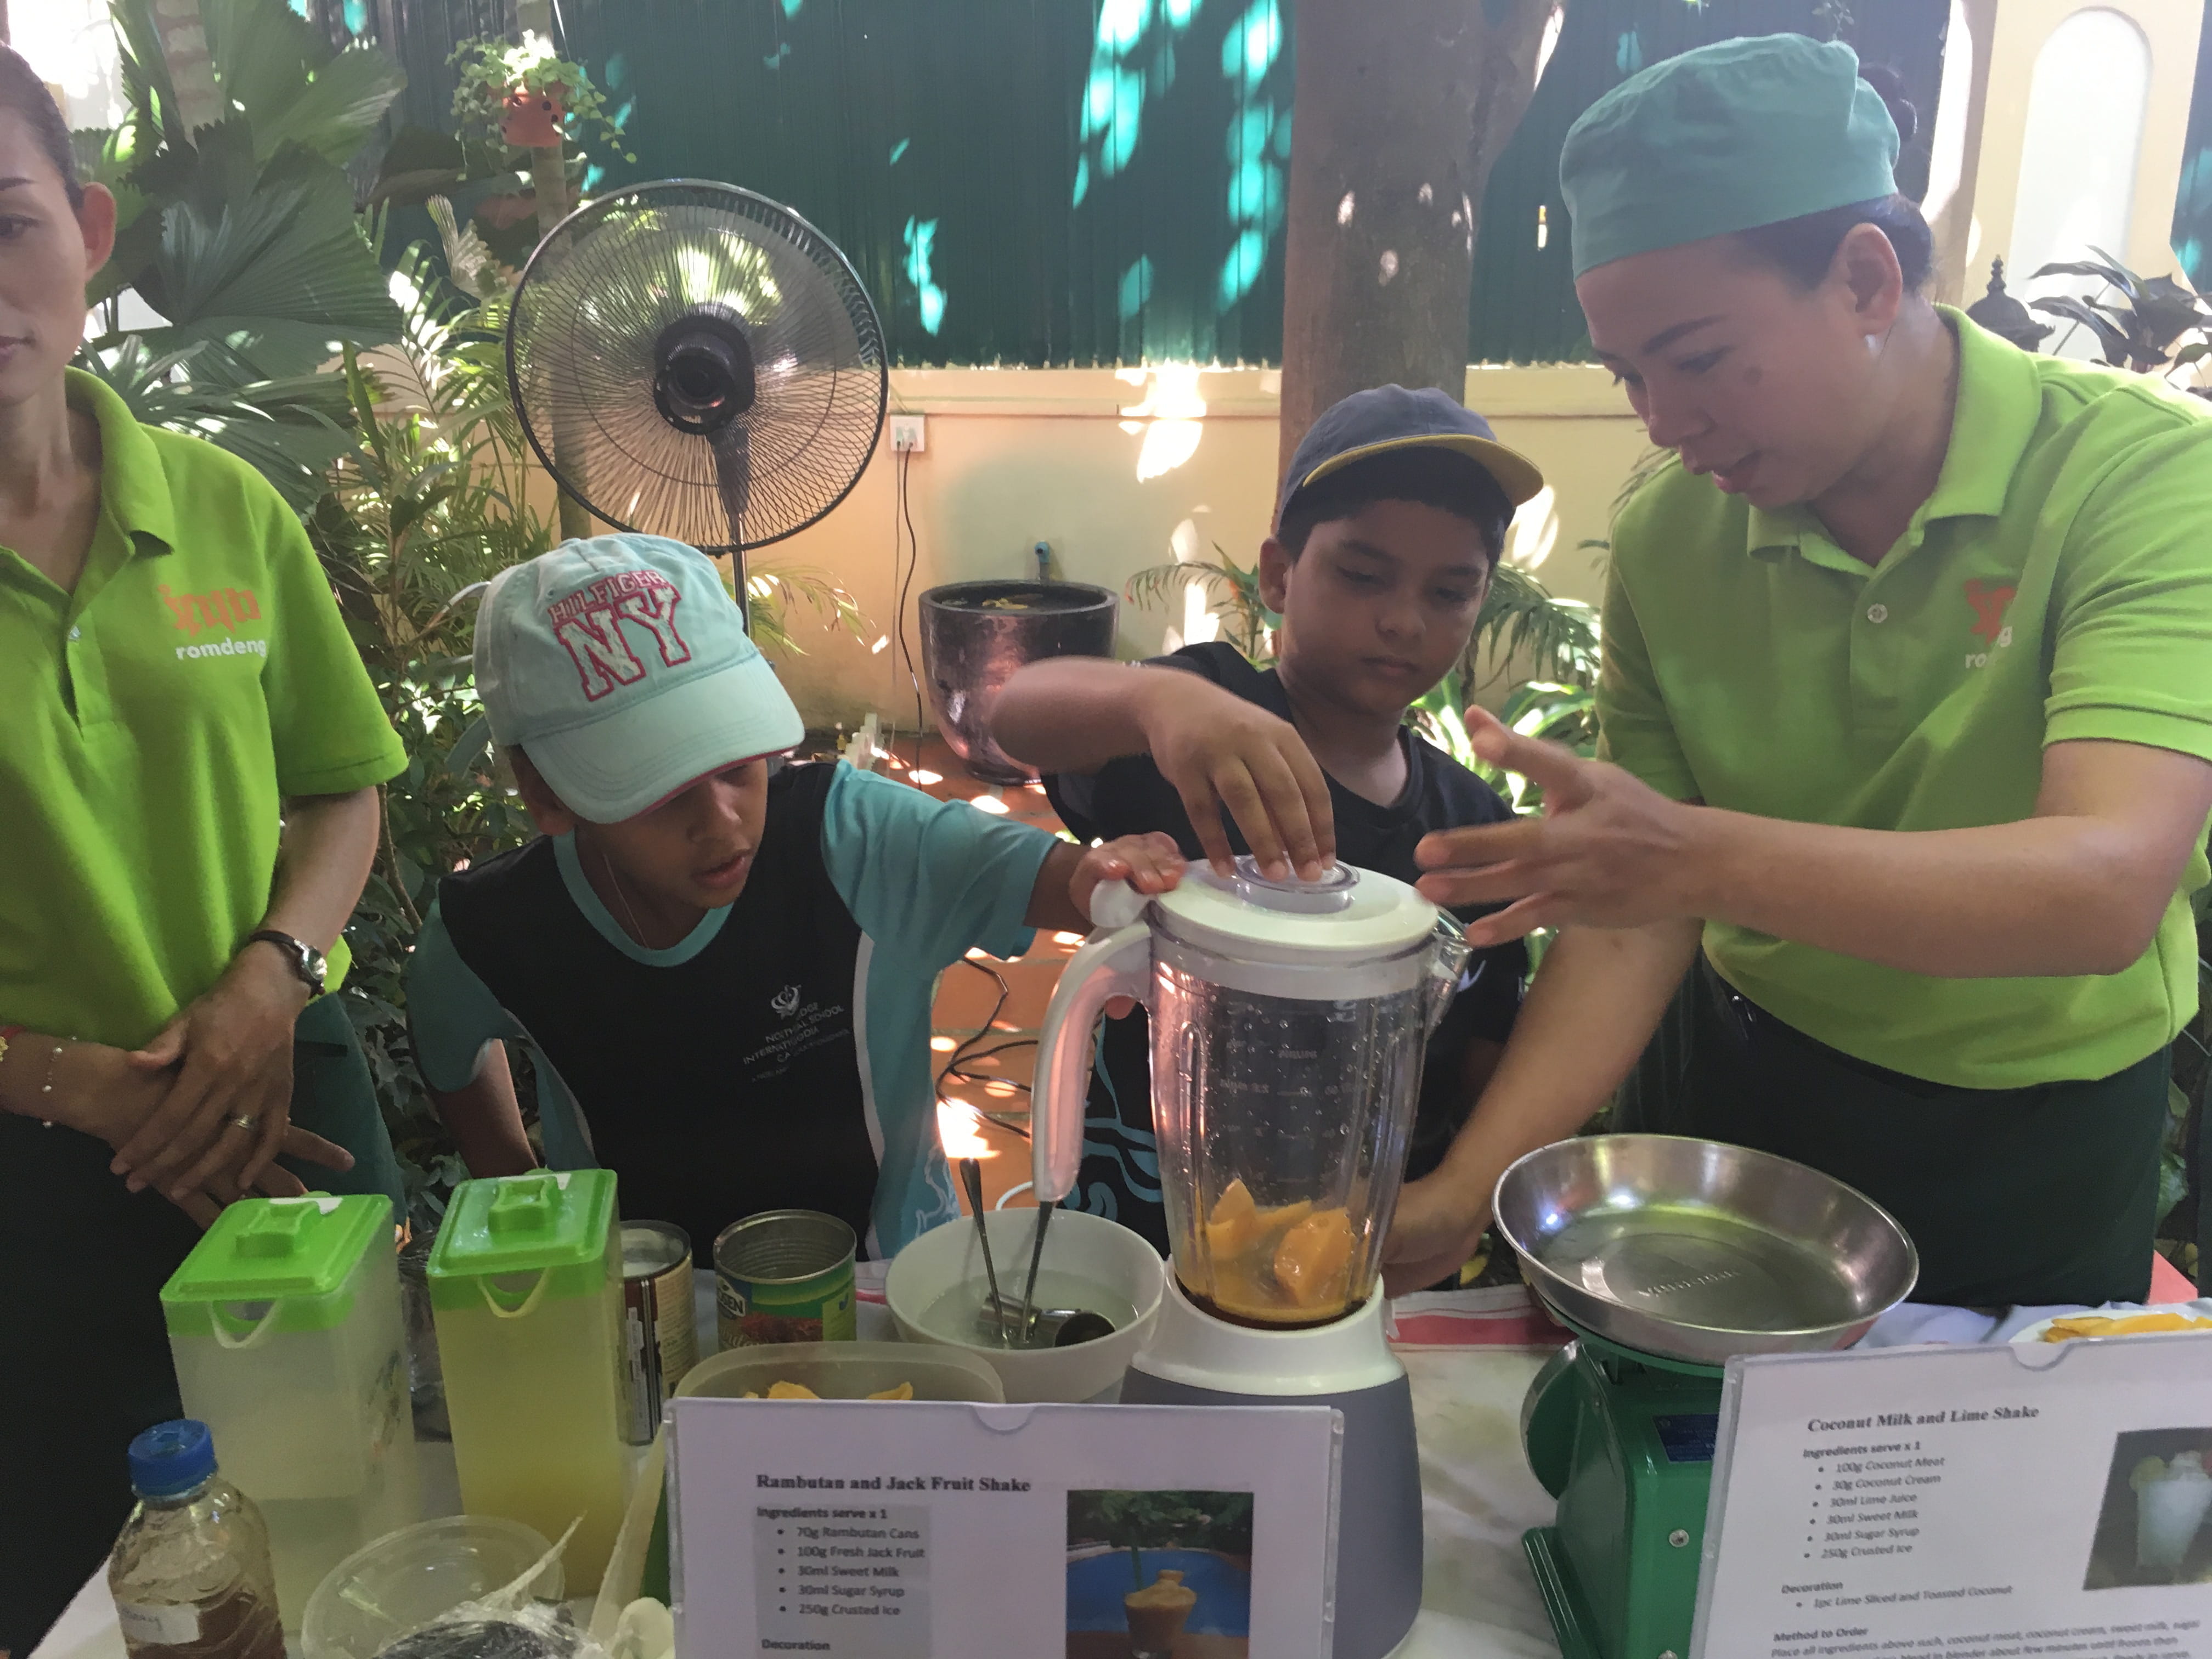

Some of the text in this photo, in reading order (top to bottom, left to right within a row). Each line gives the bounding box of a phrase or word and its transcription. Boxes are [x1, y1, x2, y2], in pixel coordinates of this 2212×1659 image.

[548, 569, 669, 627] HILFIGER
[176, 636, 267, 661] romdeng
[553, 583, 692, 702] NY
[1808, 1406, 2039, 1431] Coconut Milk and Lime Shake
[1803, 1446, 1867, 1459] Ingredients
[1871, 1443, 1901, 1453] serve
[1837, 1458, 1945, 1474] 100g Coconut Meat
[757, 1474, 1031, 1492] Rambutan and Jack Fruit Shake
[1832, 1475, 1941, 1491] 30g Coconut Cream
[1830, 1494, 1917, 1507] 30ml Lime Juice
[757, 1506, 828, 1520] Ingredients
[832, 1510, 866, 1519] serve
[1858, 1512, 1891, 1522] Sweet
[1894, 1510, 1919, 1519] Milk
[797, 1527, 919, 1539] 70g Rambutan Cans
[1855, 1530, 1884, 1540] Sugar
[1888, 1528, 1920, 1538] Syrup
[798, 1546, 925, 1558] 100g Fresh Jack Fruit
[1851, 1545, 1894, 1556] Crusted
[798, 1566, 900, 1577] 30ml Sweet Milk
[798, 1585, 905, 1597] 30ml Sugar Syrup
[1781, 1582, 1843, 1594] Decoration
[1836, 1597, 1862, 1606] Lime
[1899, 1592, 1920, 1602] and
[1968, 1585, 2013, 1596] Coconut
[799, 1604, 901, 1616] 250g Crusted Ice
[1774, 1627, 1869, 1641] Method to Order
[761, 1639, 831, 1650] Decoration
